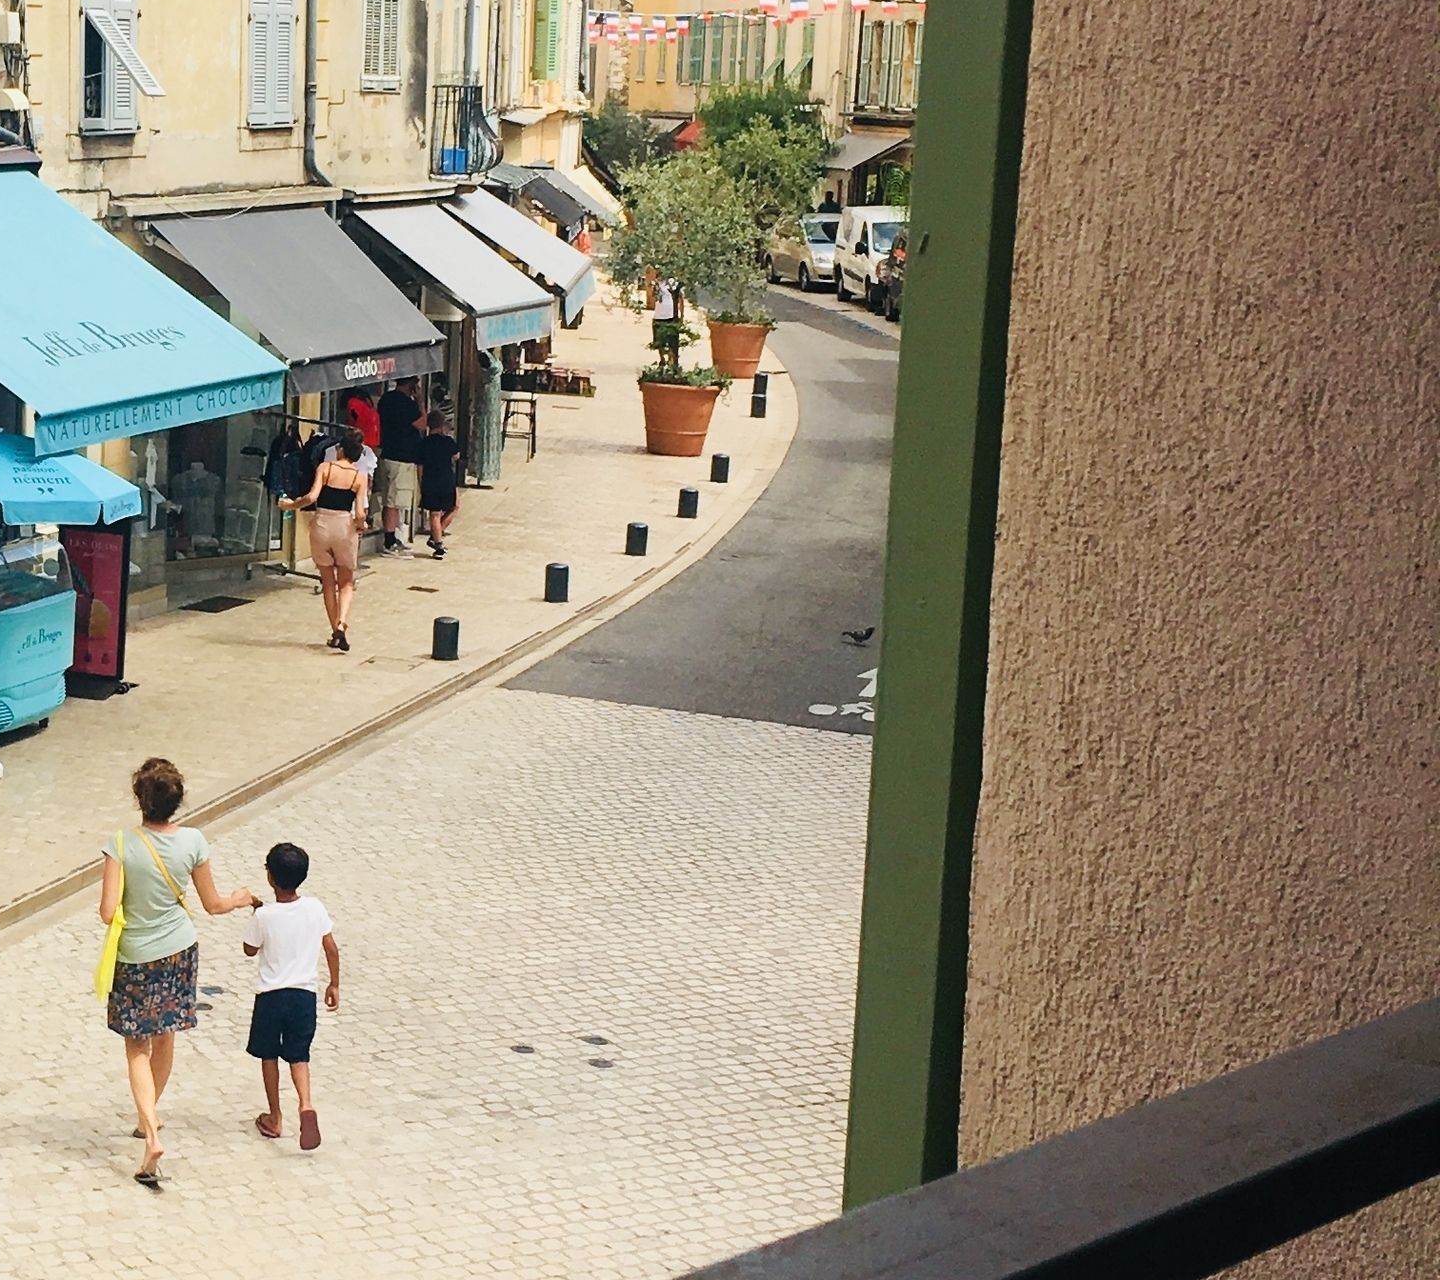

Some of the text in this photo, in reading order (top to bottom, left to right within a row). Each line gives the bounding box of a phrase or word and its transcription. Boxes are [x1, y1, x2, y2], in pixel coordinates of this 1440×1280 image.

[21, 321, 186, 367] Jeff de Bruges
[47, 380, 274, 443] NATURELLEMENT CHOCOLAT
